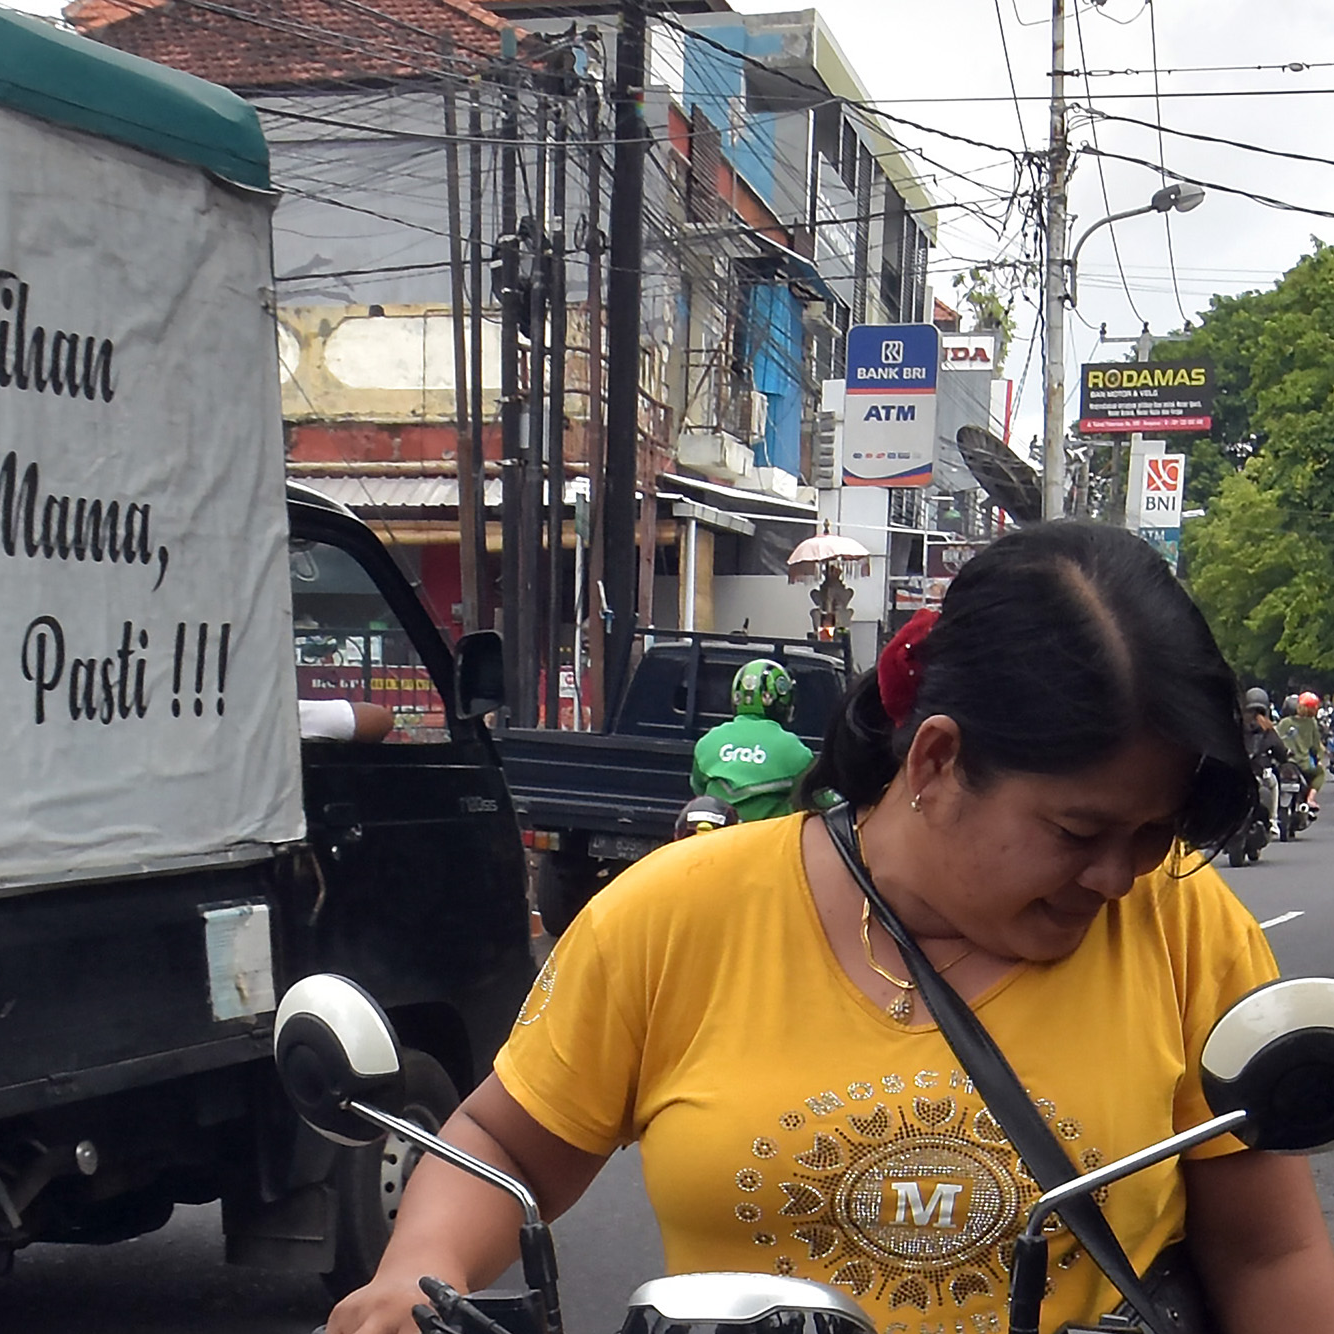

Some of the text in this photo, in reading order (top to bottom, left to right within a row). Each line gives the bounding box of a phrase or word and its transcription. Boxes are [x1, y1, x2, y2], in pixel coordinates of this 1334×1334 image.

[857, 367, 926, 380] BANK BRI
[1088, 368, 1205, 388] RODAMAS
[863, 405, 916, 421] ATM
[1146, 496, 1175, 511] BNI
[22, 616, 148, 724] Pasti
[719, 743, 767, 764] Grab
[890, 1182, 963, 1228] M
